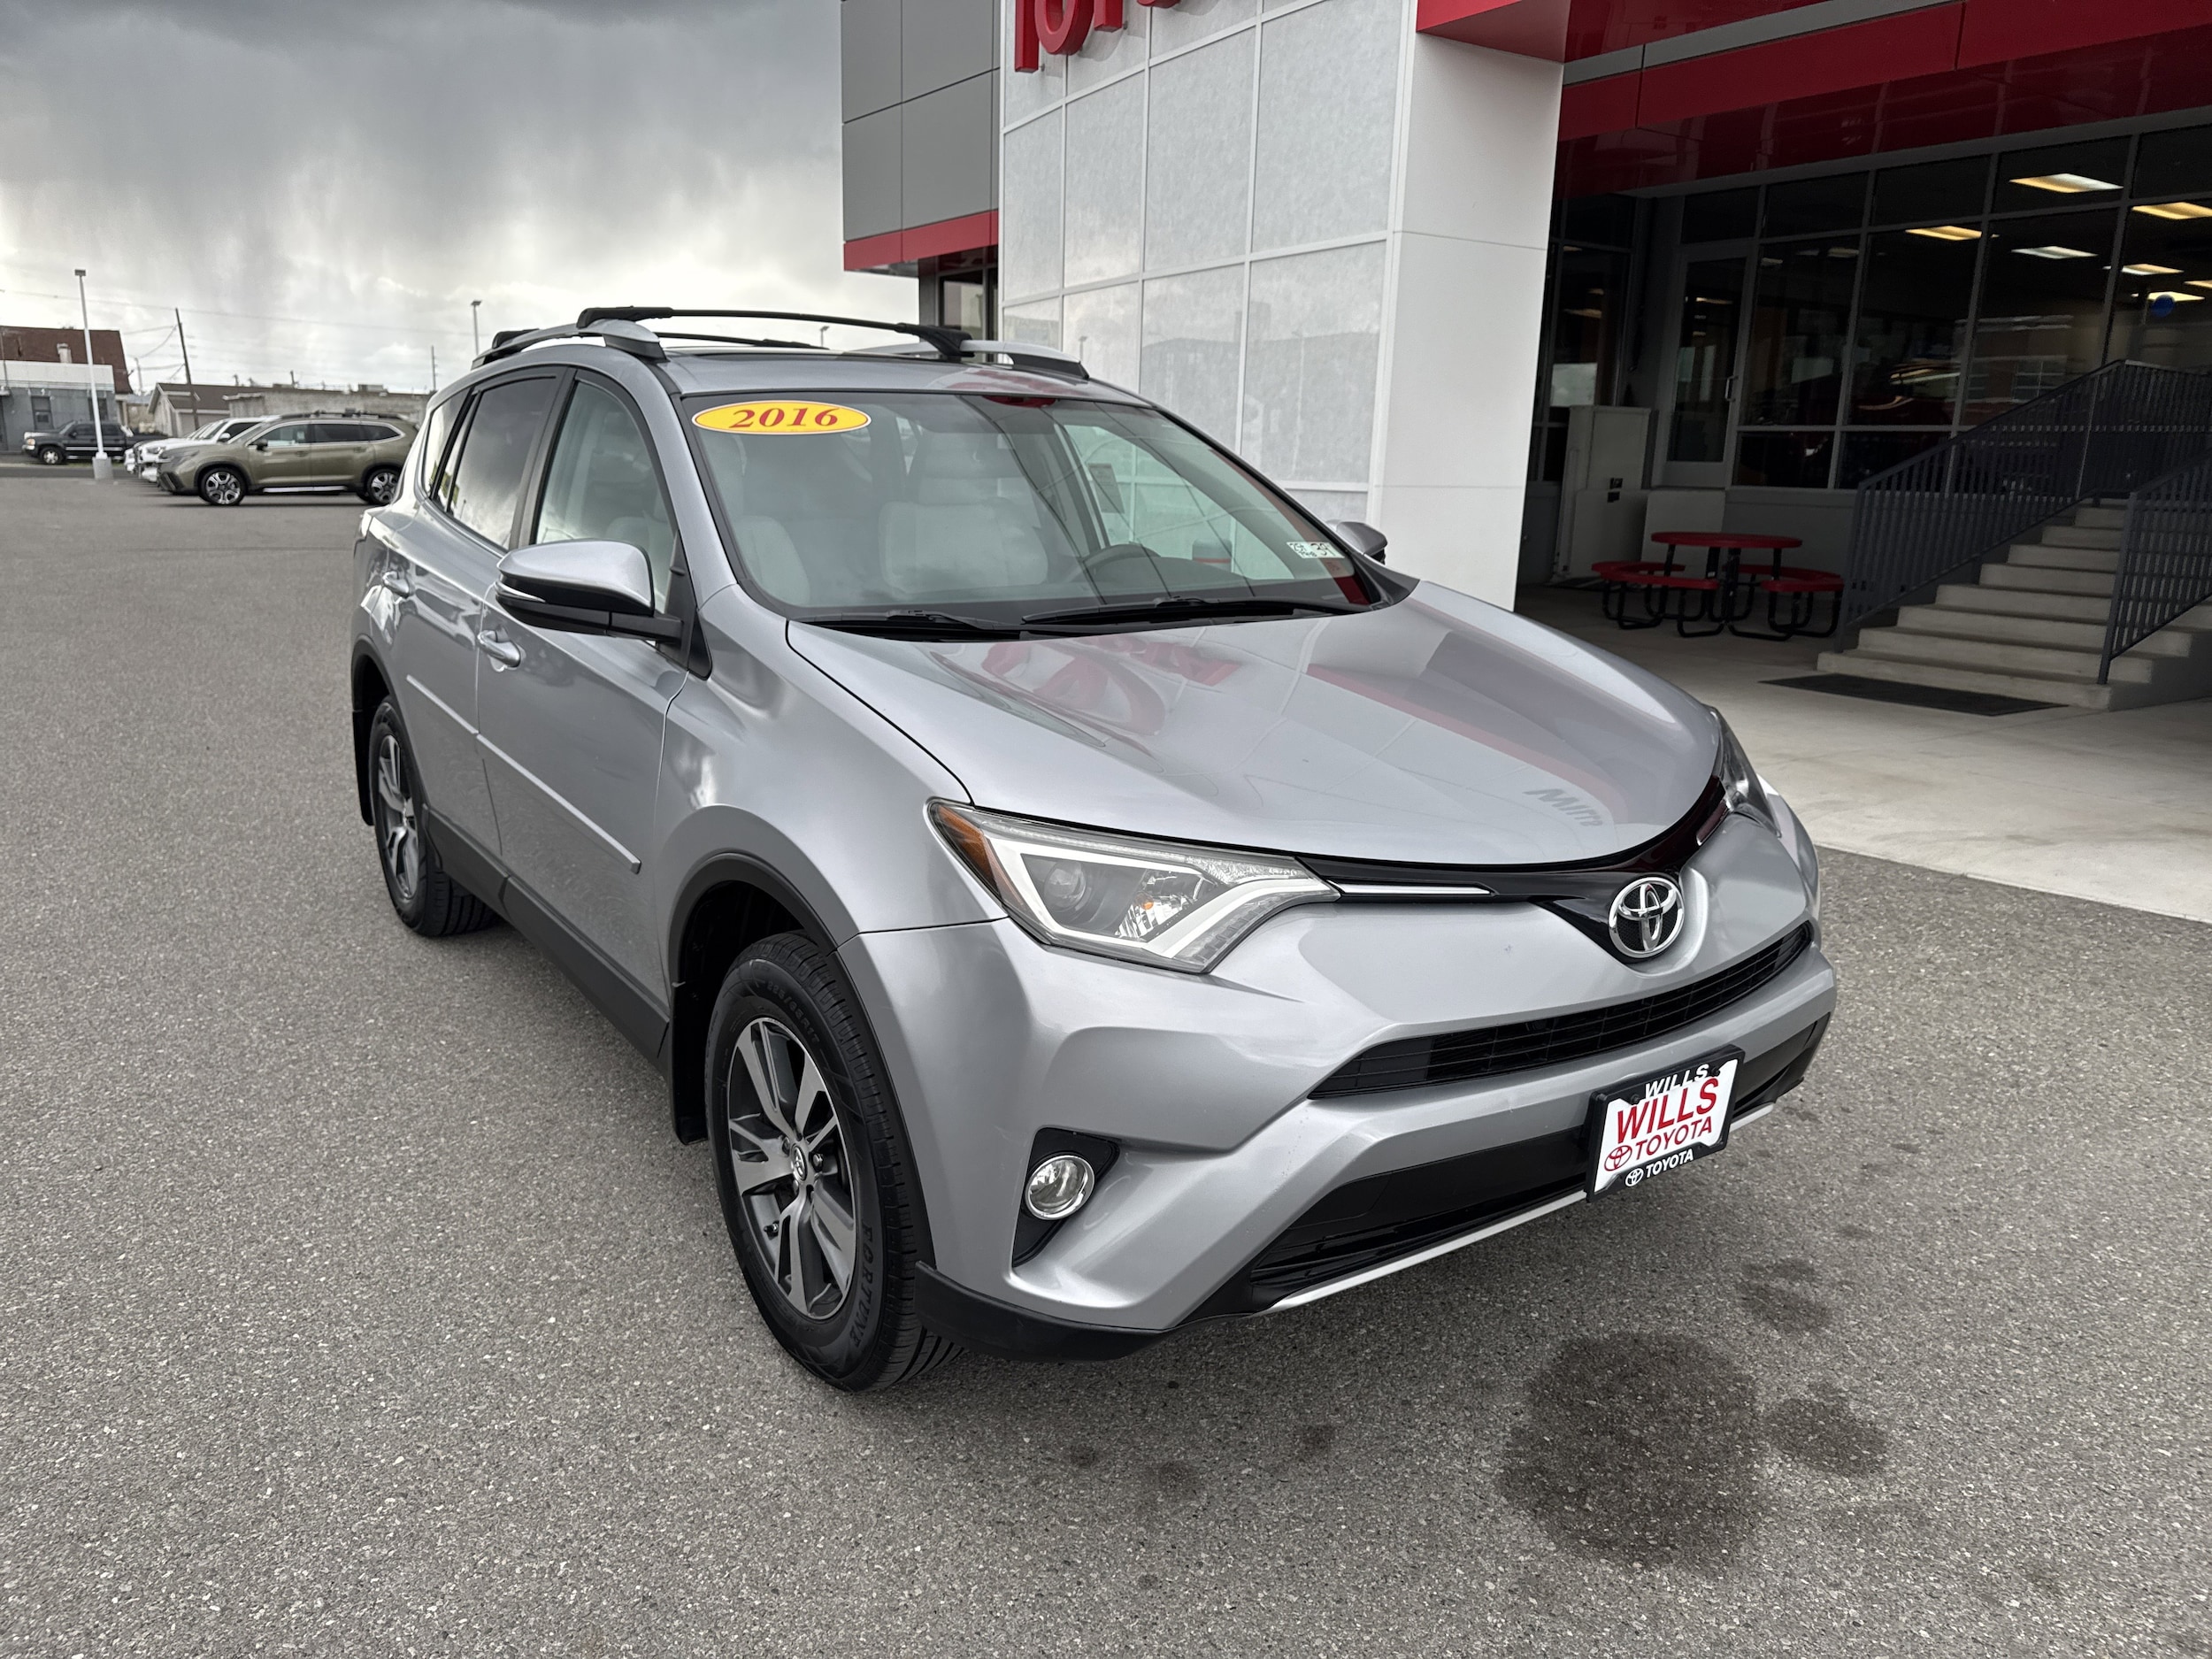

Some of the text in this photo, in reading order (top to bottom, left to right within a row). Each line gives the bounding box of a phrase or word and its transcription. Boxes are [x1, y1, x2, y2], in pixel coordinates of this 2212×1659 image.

[728, 407, 841, 428] 2016
[1645, 1064, 1709, 1099] WILLS
[1617, 1078, 1718, 1144] WILLS
[1635, 1116, 1712, 1160] TOYOTA
[1646, 1148, 1694, 1179] TOYOTA
[849, 1220, 874, 1348] FORTUNE
